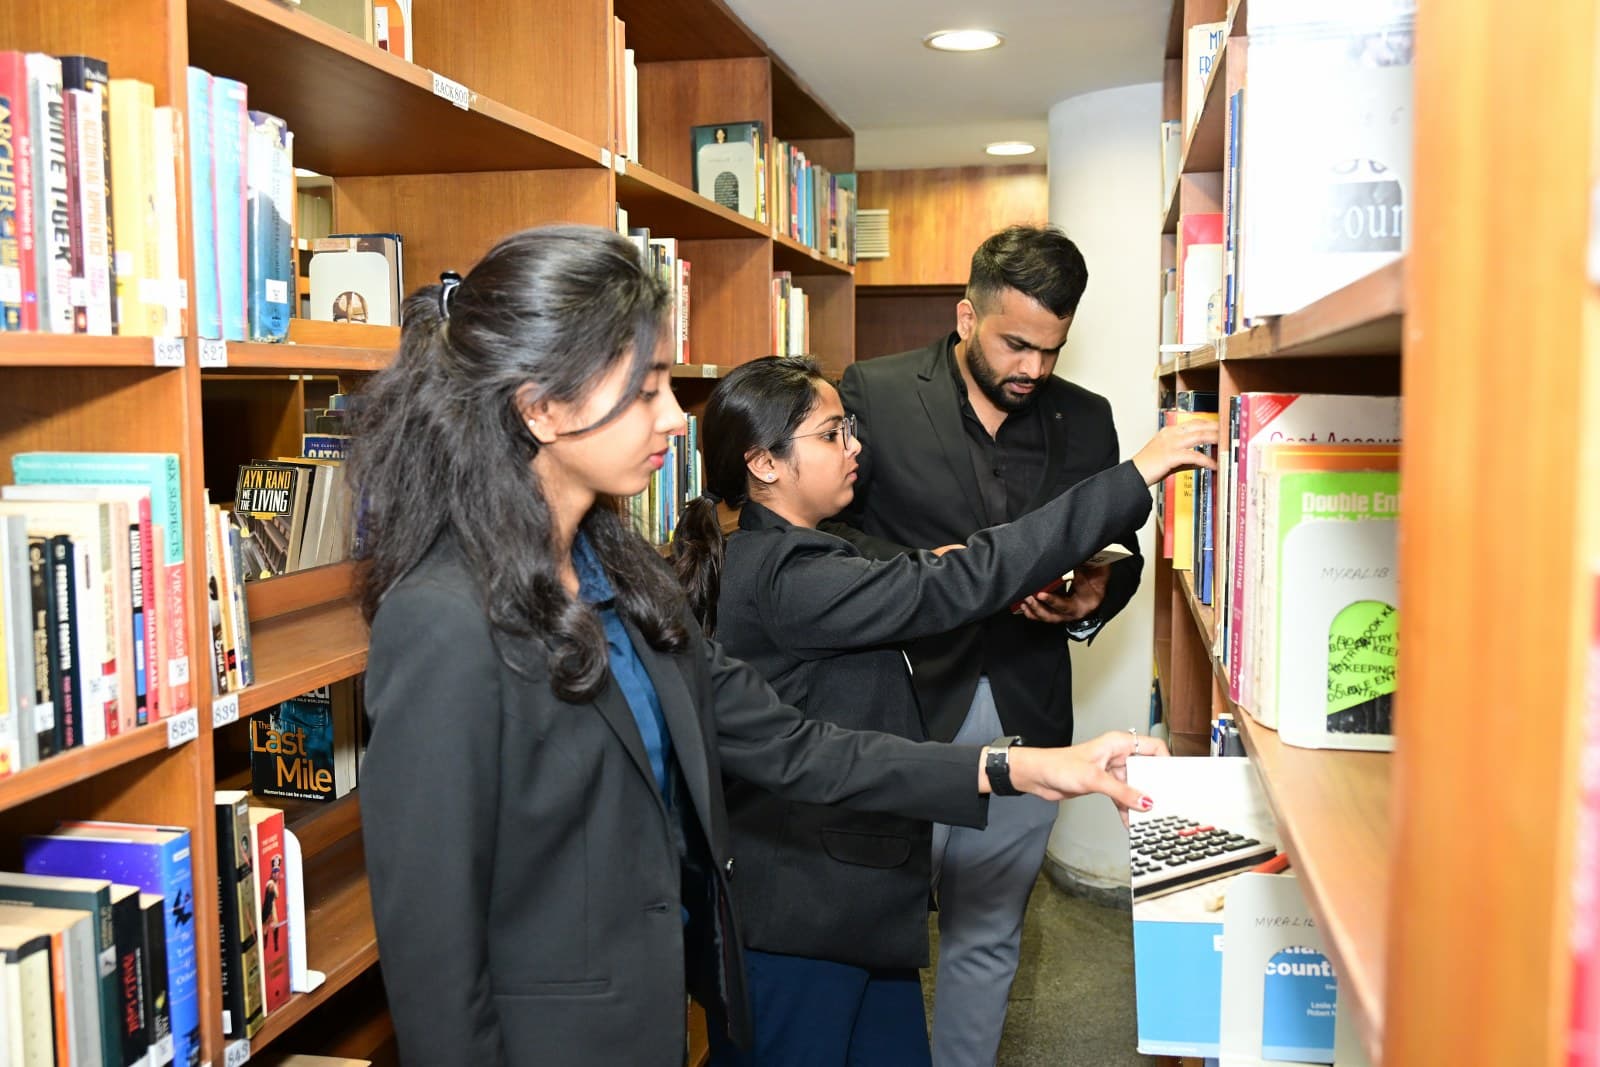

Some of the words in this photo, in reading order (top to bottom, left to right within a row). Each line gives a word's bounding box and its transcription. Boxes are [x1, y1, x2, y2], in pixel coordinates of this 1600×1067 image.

[0, 103, 17, 212] ARCHER
[167, 458, 176, 482] SIX
[243, 470, 264, 488] AYN
[265, 470, 292, 489] RAND
[240, 500, 251, 511] THE
[242, 490, 252, 500] WE
[252, 489, 289, 512] LIVING
[1302, 492, 1369, 513] Double
[168, 487, 180, 557] SUSPECTS
[1236, 515, 1247, 591] Accounting
[171, 568, 183, 616] VIKAS
[258, 720, 271, 730] The
[253, 720, 307, 756] Last
[277, 755, 332, 793] Mile
